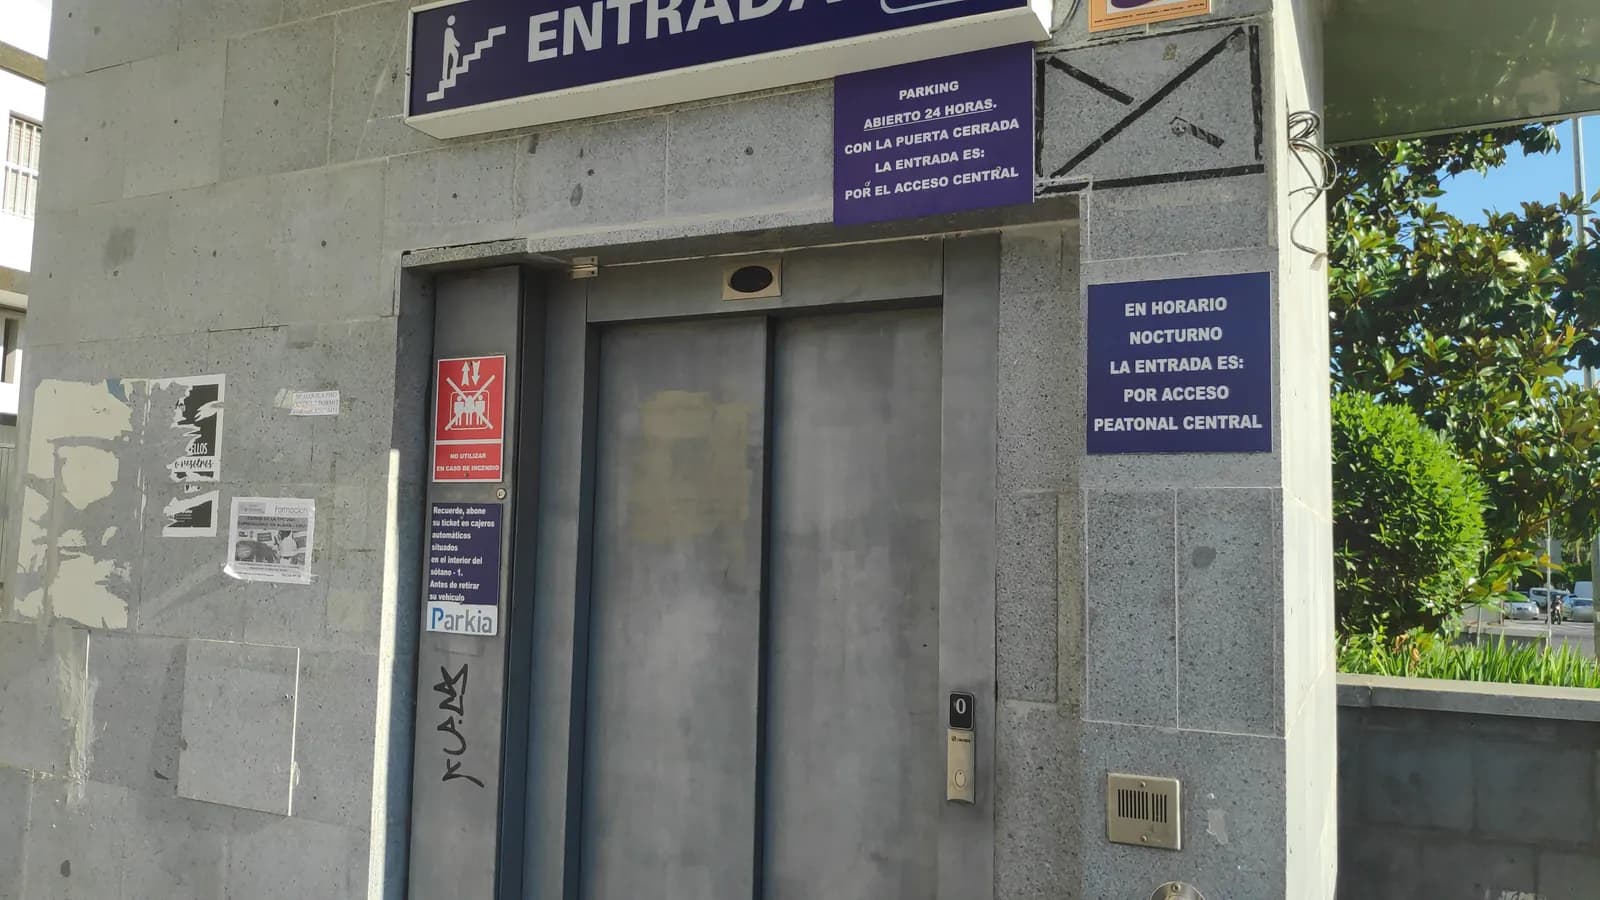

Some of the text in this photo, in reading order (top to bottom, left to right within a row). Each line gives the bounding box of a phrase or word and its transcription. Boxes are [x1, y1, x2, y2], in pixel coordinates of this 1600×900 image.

[899, 81, 959, 100] PARKING
[864, 99, 997, 129] ABIERTO 24 HORAS.
[845, 119, 1019, 154] CON LA PUERTA CERRADA
[875, 148, 985, 173] LA ENTRADA ES:
[845, 167, 1018, 200] POR EL ACCESO CENTRAL
[1125, 298, 1227, 316] EN HORARIO
[1130, 327, 1222, 344] NOCTURNO
[1110, 356, 1243, 374] LA ENTRADA ES:
[1124, 386, 1229, 402] POR ACCESO
[1094, 415, 1262, 431] PEATONAL CENTRAL
[433, 507, 464, 515] Recuerde,
[441, 519, 460, 527] ticket
[471, 520, 495, 528] cajeros
[432, 543, 458, 551] situados
[448, 556, 471, 564] interior
[431, 568, 451, 576] sótano
[430, 580, 480, 590] Antes de retirar
[431, 607, 493, 634] Parkia
[955, 697, 967, 714] 0
